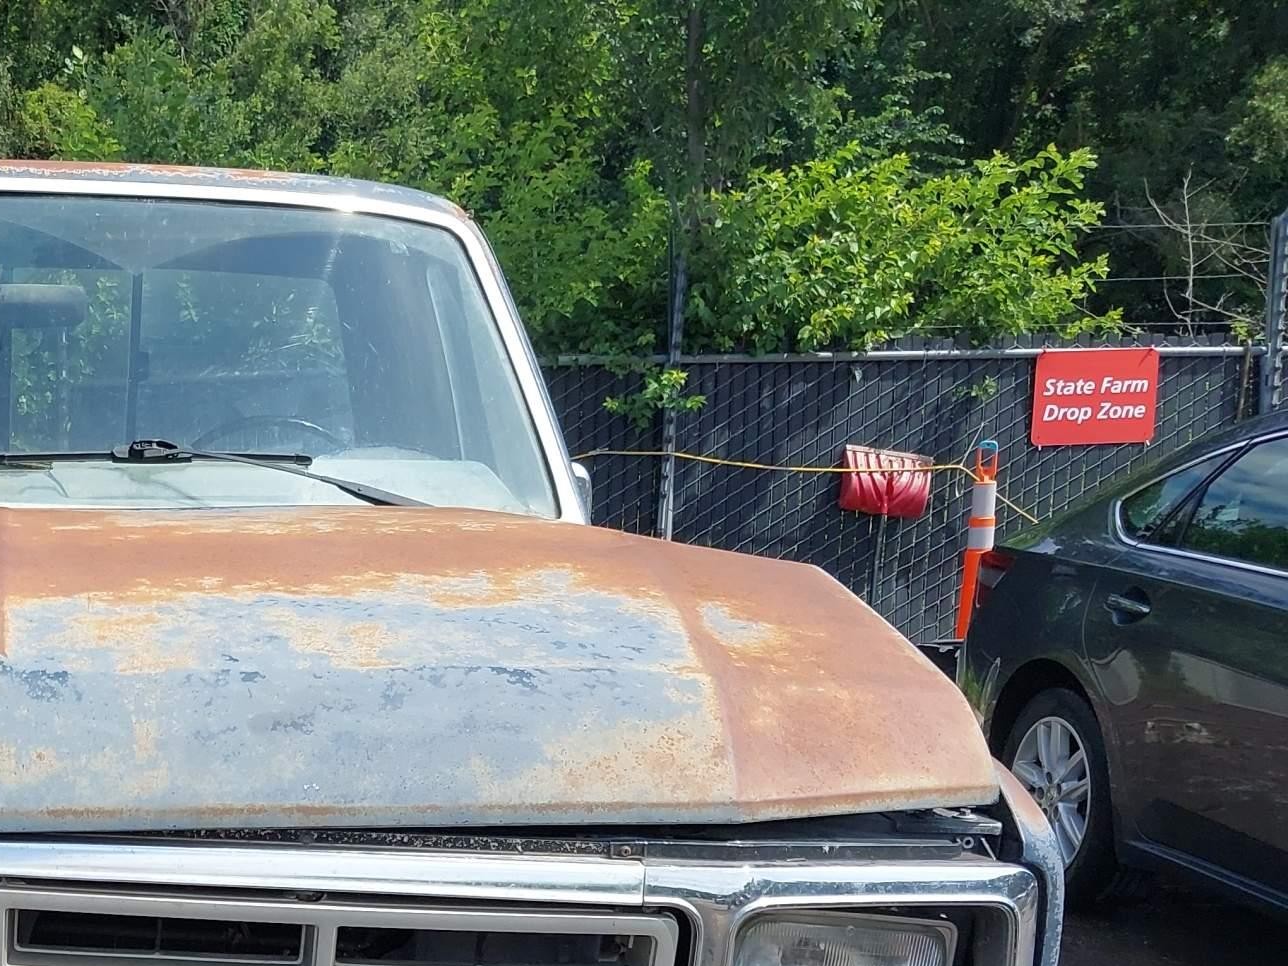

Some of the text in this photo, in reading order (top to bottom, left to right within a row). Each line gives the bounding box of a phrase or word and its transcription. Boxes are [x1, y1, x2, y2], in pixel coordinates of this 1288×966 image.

[1043, 376, 1149, 396] State Farm
[1043, 402, 1146, 424] Drop Zone
